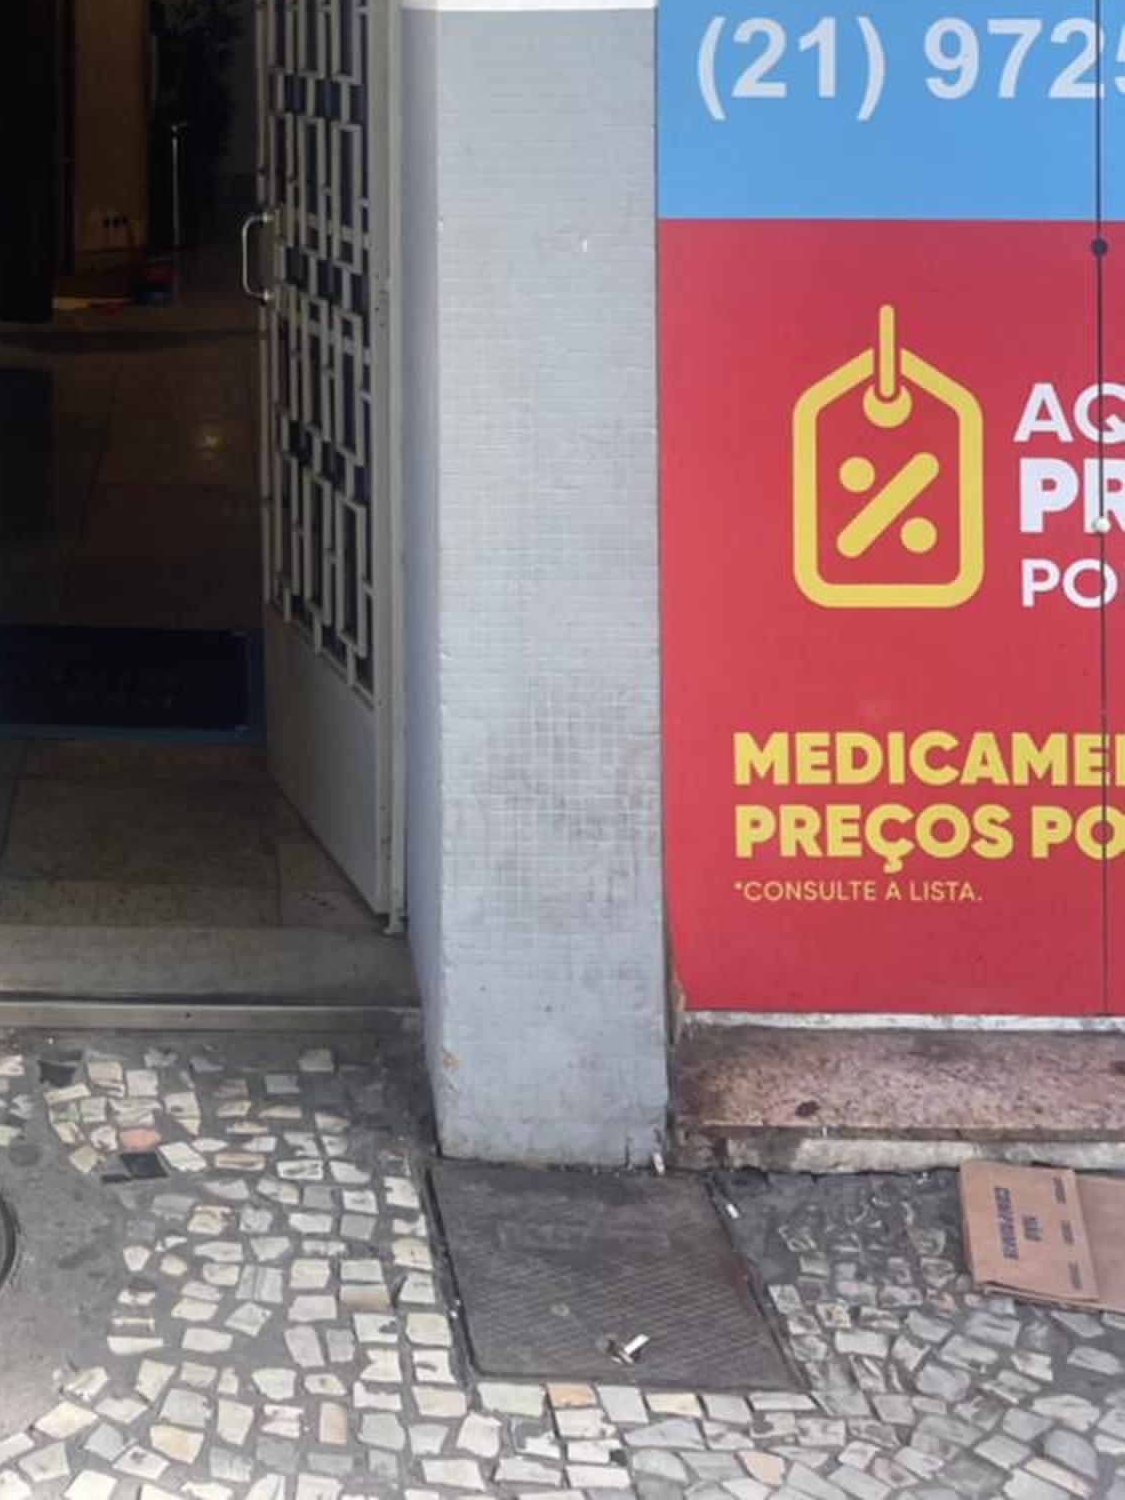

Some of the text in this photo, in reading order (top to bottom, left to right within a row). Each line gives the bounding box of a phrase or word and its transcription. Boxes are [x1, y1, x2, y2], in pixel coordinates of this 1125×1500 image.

[697, 16, 1125, 120] (21) 972
[1019, 457, 1125, 533] PR
[733, 731, 1125, 787] MEDICAME
[735, 803, 1014, 874] PREÇOS
[909, 881, 983, 902] LISTA.
